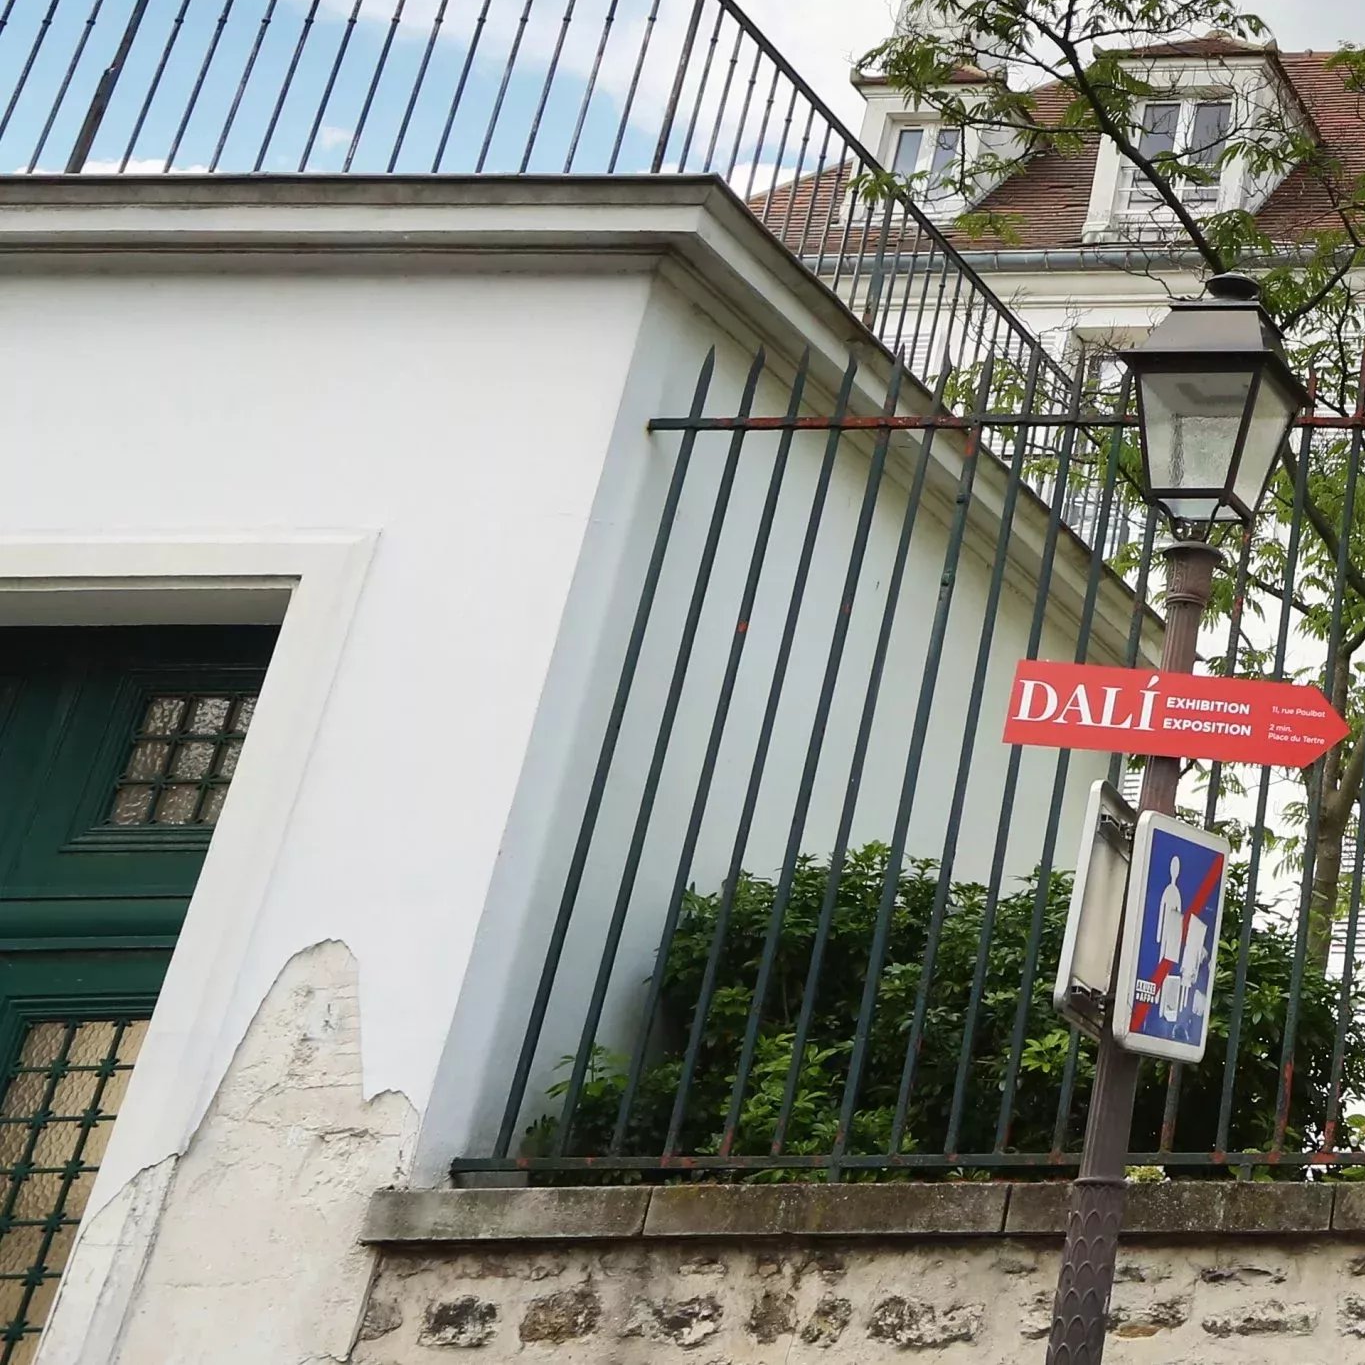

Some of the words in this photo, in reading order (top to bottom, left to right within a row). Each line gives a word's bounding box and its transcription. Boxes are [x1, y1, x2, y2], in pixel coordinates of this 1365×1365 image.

[1012, 675, 1160, 731] DALÍ
[1167, 697, 1250, 714] EXHIBITION
[1295, 709, 1326, 718] Poulbot
[1163, 718, 1251, 736] EXPOSITION
[1268, 732, 1289, 741] Place
[1303, 736, 1325, 744] Tertre
